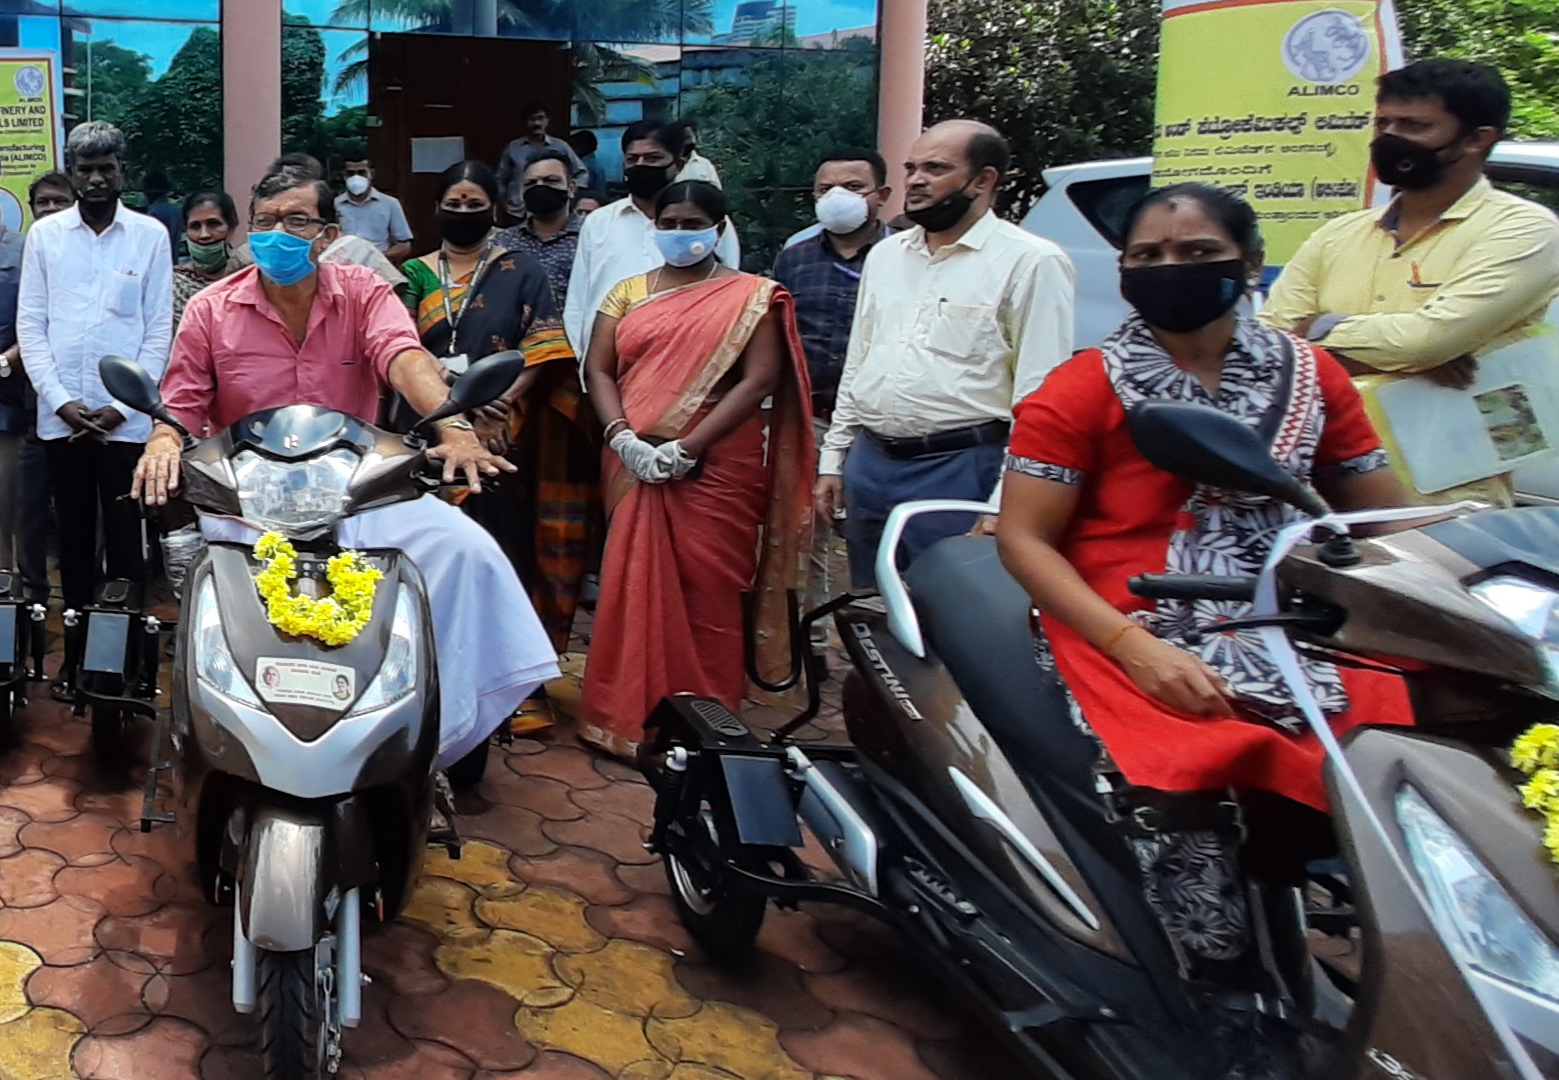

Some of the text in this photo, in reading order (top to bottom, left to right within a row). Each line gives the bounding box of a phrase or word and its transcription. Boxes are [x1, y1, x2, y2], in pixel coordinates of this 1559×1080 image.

[1288, 85, 1359, 96] ALIMCO
[29, 105, 46, 115] AND
[12, 118, 44, 128] LIMITED
[849, 623, 911, 699] DESTINI
